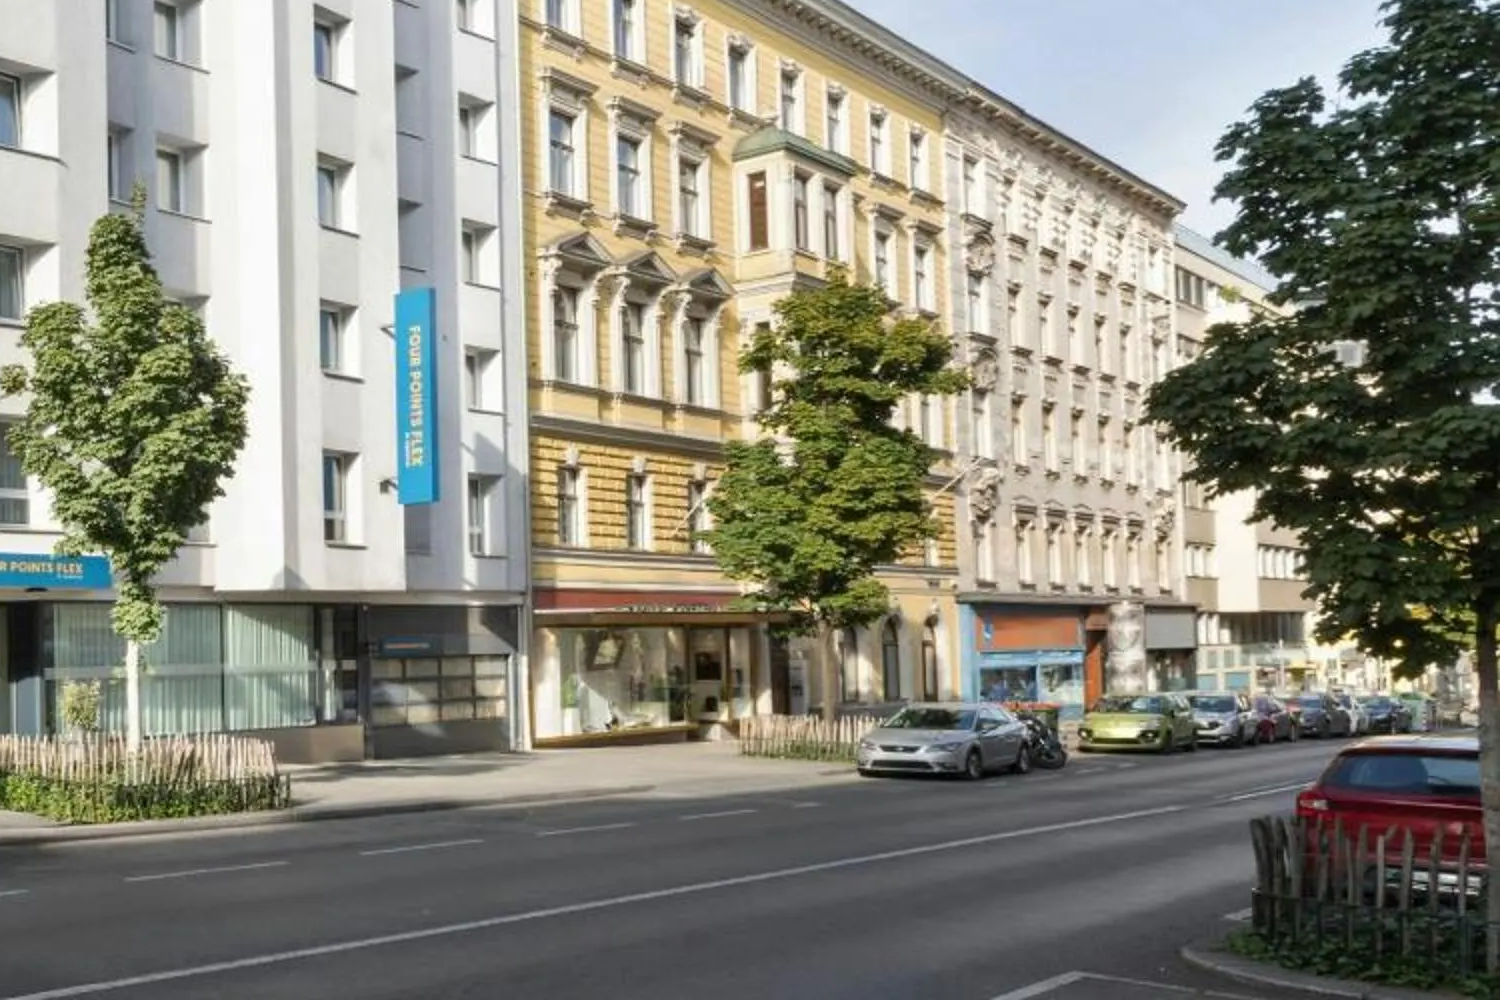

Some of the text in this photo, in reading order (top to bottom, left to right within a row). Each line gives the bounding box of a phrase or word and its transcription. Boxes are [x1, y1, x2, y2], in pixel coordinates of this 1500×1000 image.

[408, 326, 423, 467] FOUR POINTS FLEX
[9, 561, 53, 574] POINTS
[56, 562, 84, 574] FLEX
